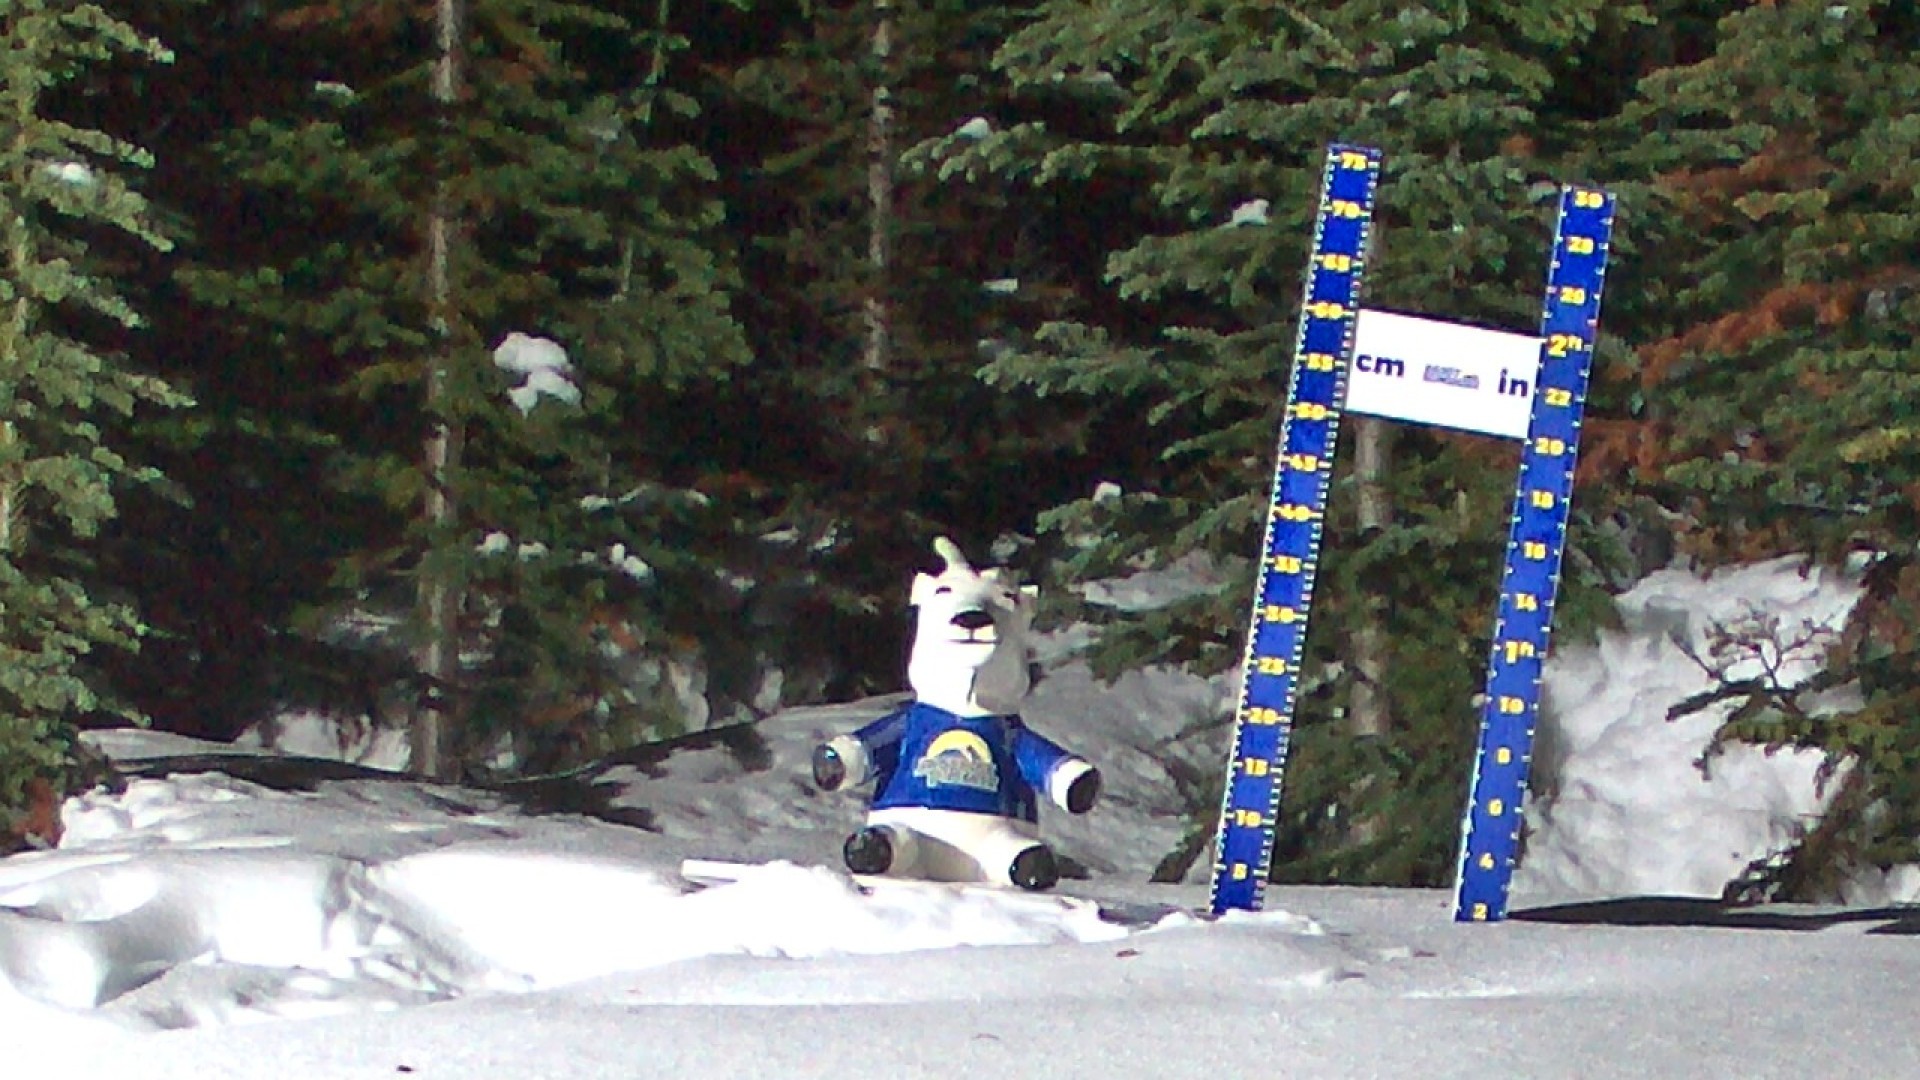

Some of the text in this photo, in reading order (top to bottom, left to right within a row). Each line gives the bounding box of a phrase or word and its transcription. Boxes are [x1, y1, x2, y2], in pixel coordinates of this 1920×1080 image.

[1340, 152, 1367, 170] 75
[1574, 190, 1603, 207] 30
[1332, 200, 1360, 218] 70
[1356, 354, 1404, 378] cm
[1498, 367, 1528, 397] in
[1535, 437, 1565, 455] 20
[1531, 490, 1554, 509] 18
[1515, 593, 1537, 611] 14
[1264, 605, 1295, 622] 30
[1258, 657, 1285, 675] 25
[1500, 696, 1524, 713] 10
[1250, 707, 1278, 724] 20
[1497, 747, 1511, 763] 8
[1245, 758, 1268, 776] 15
[1488, 799, 1503, 815] 6
[1236, 809, 1262, 826] 10
[1479, 853, 1494, 868] 4
[1232, 863, 1247, 880] 5
[1473, 903, 1487, 920] 2
